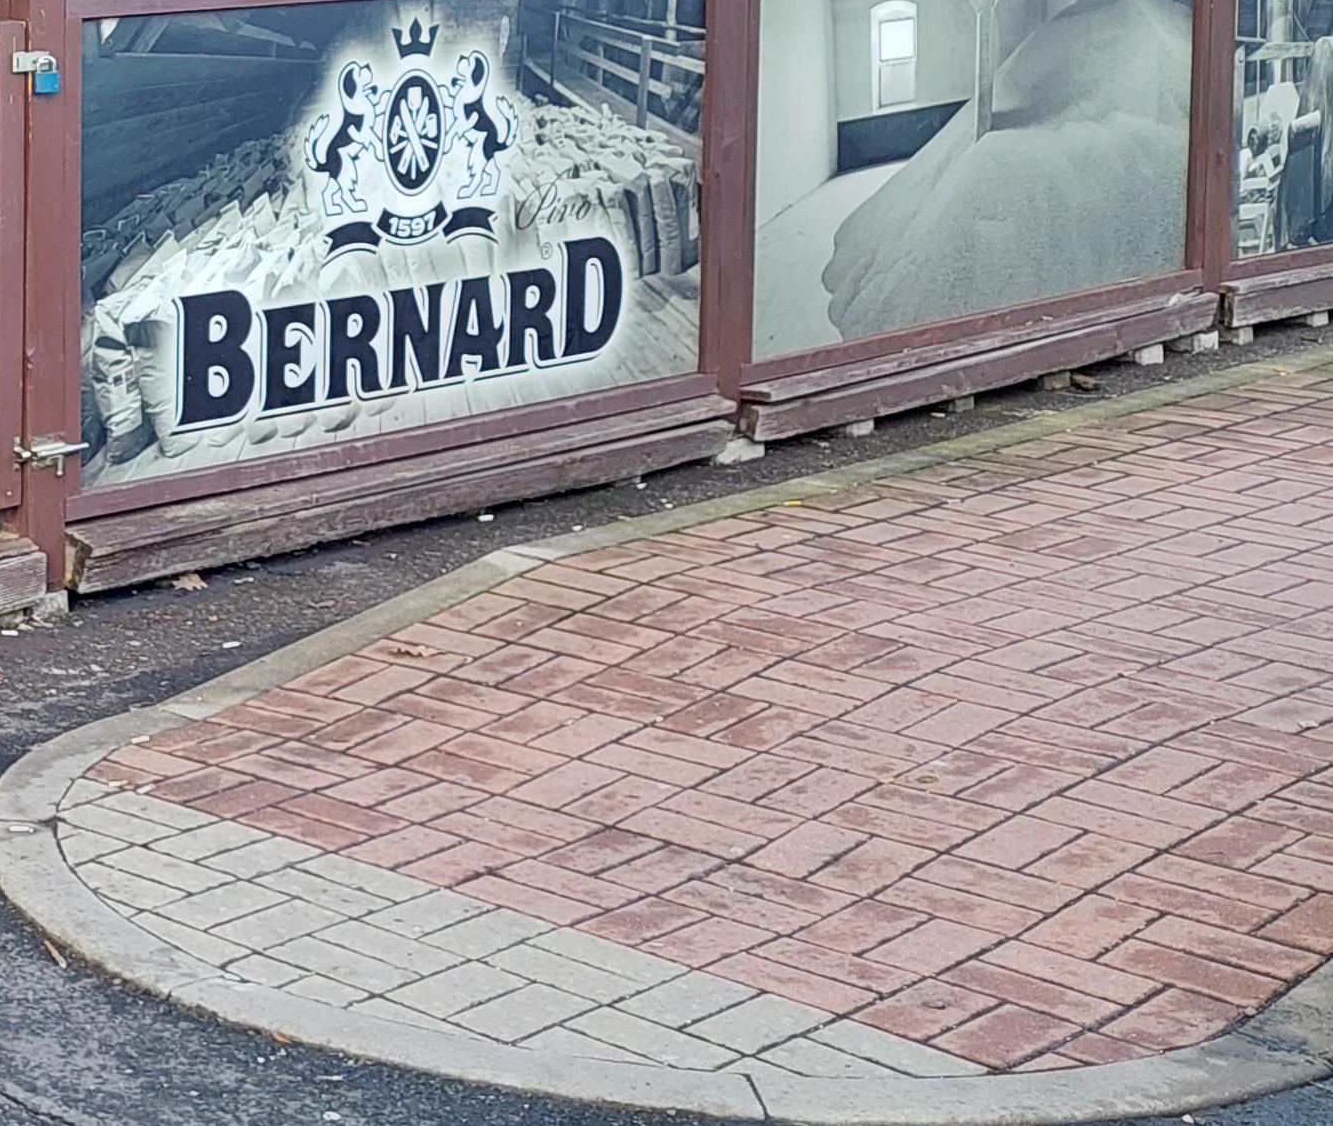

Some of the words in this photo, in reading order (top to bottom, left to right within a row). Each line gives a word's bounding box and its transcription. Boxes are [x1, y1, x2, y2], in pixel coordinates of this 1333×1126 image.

[388, 210, 437, 237] 1597
[515, 166, 593, 230] Pivo
[172, 235, 624, 435] BERNARD
